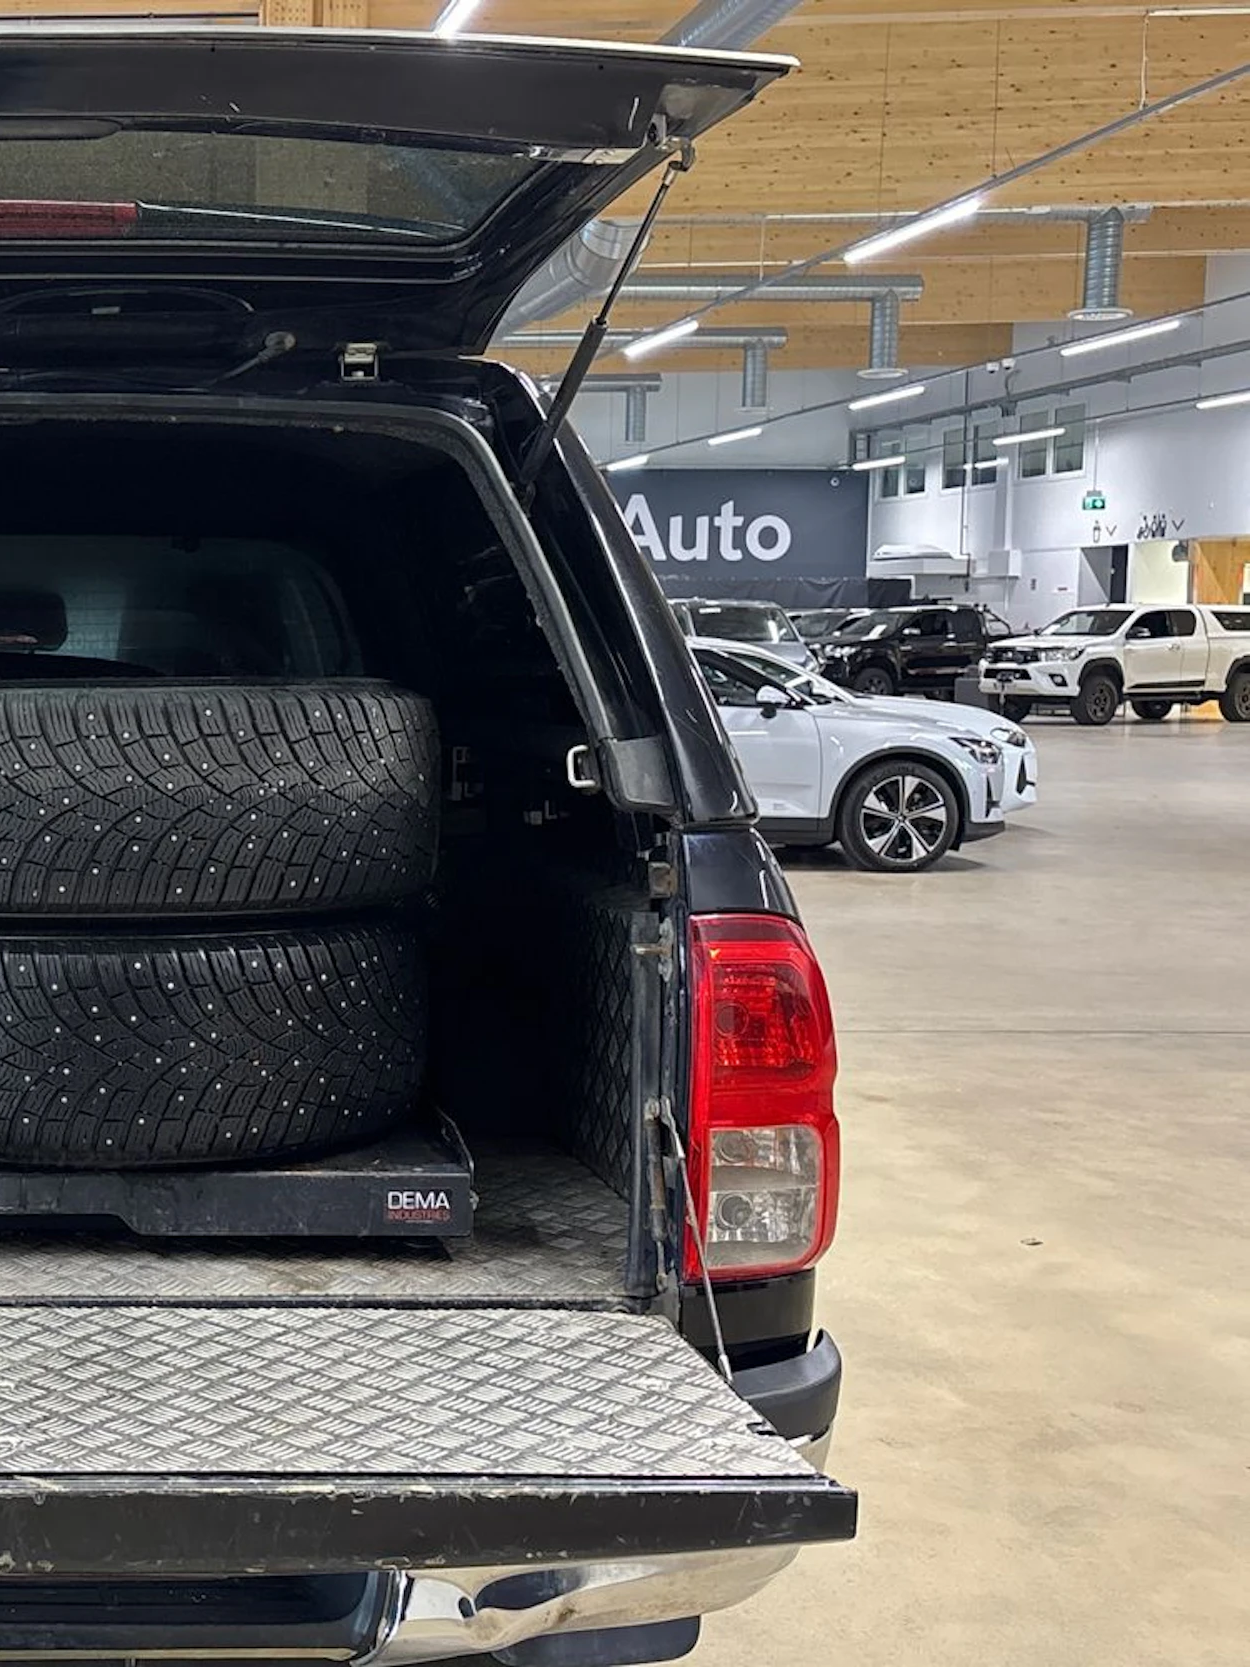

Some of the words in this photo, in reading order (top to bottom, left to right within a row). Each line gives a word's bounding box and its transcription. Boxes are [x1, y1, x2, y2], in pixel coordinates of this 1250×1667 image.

[624, 493, 792, 562] Auto
[387, 1191, 450, 1210] DEMA
[388, 1209, 450, 1220] INDUSTRIES
